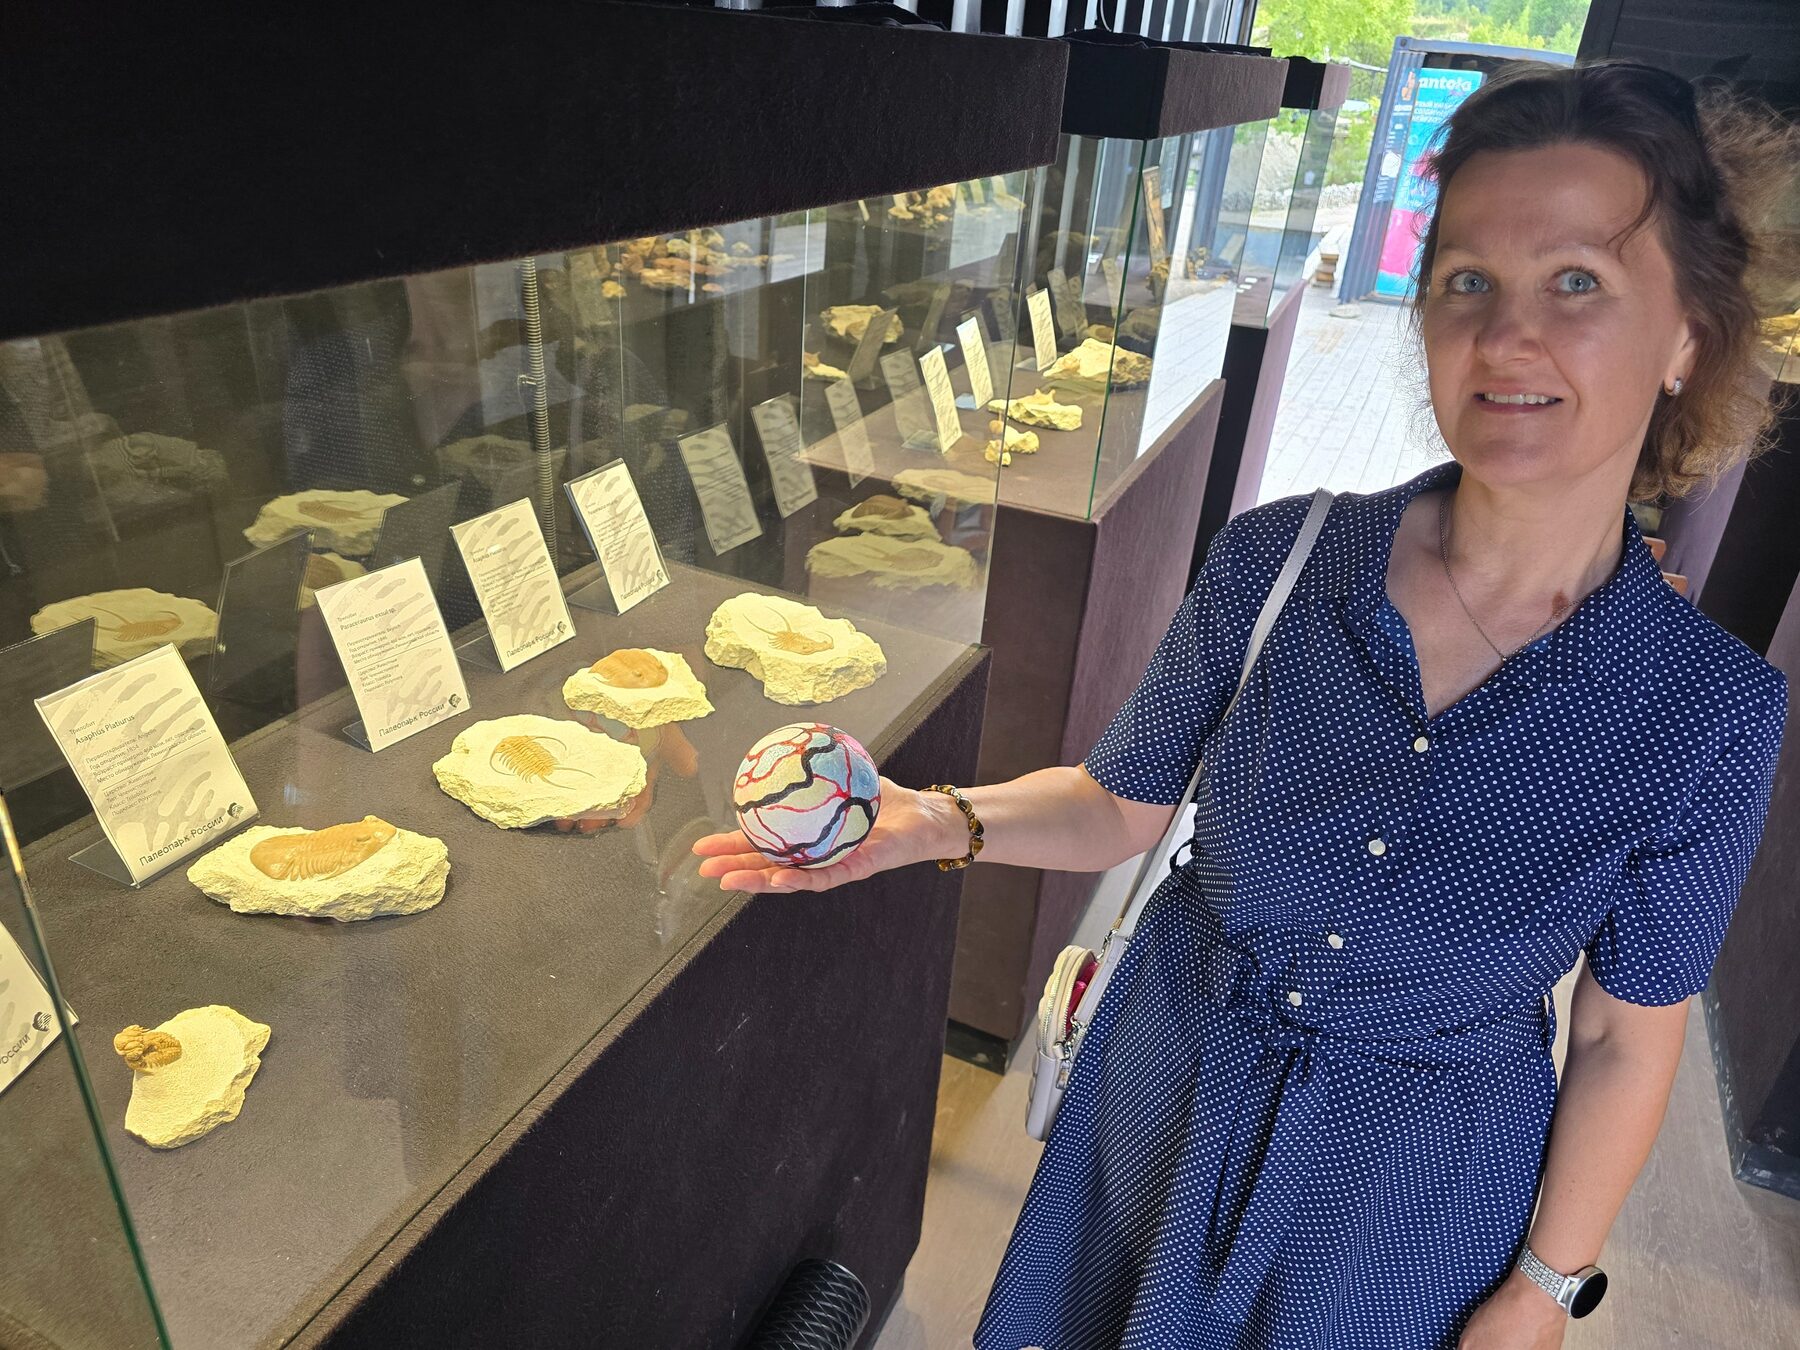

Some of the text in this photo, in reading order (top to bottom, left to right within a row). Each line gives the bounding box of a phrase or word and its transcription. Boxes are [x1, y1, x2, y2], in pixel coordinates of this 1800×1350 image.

[1418, 77, 1473, 92] antola
[69, 721, 95, 734] Трилобит
[75, 715, 135, 744] Asaphus Platiurus
[379, 703, 444, 736] Палеопарк России
[139, 816, 223, 865] Палеопарк России
[0, 1034, 30, 1064] оссии
